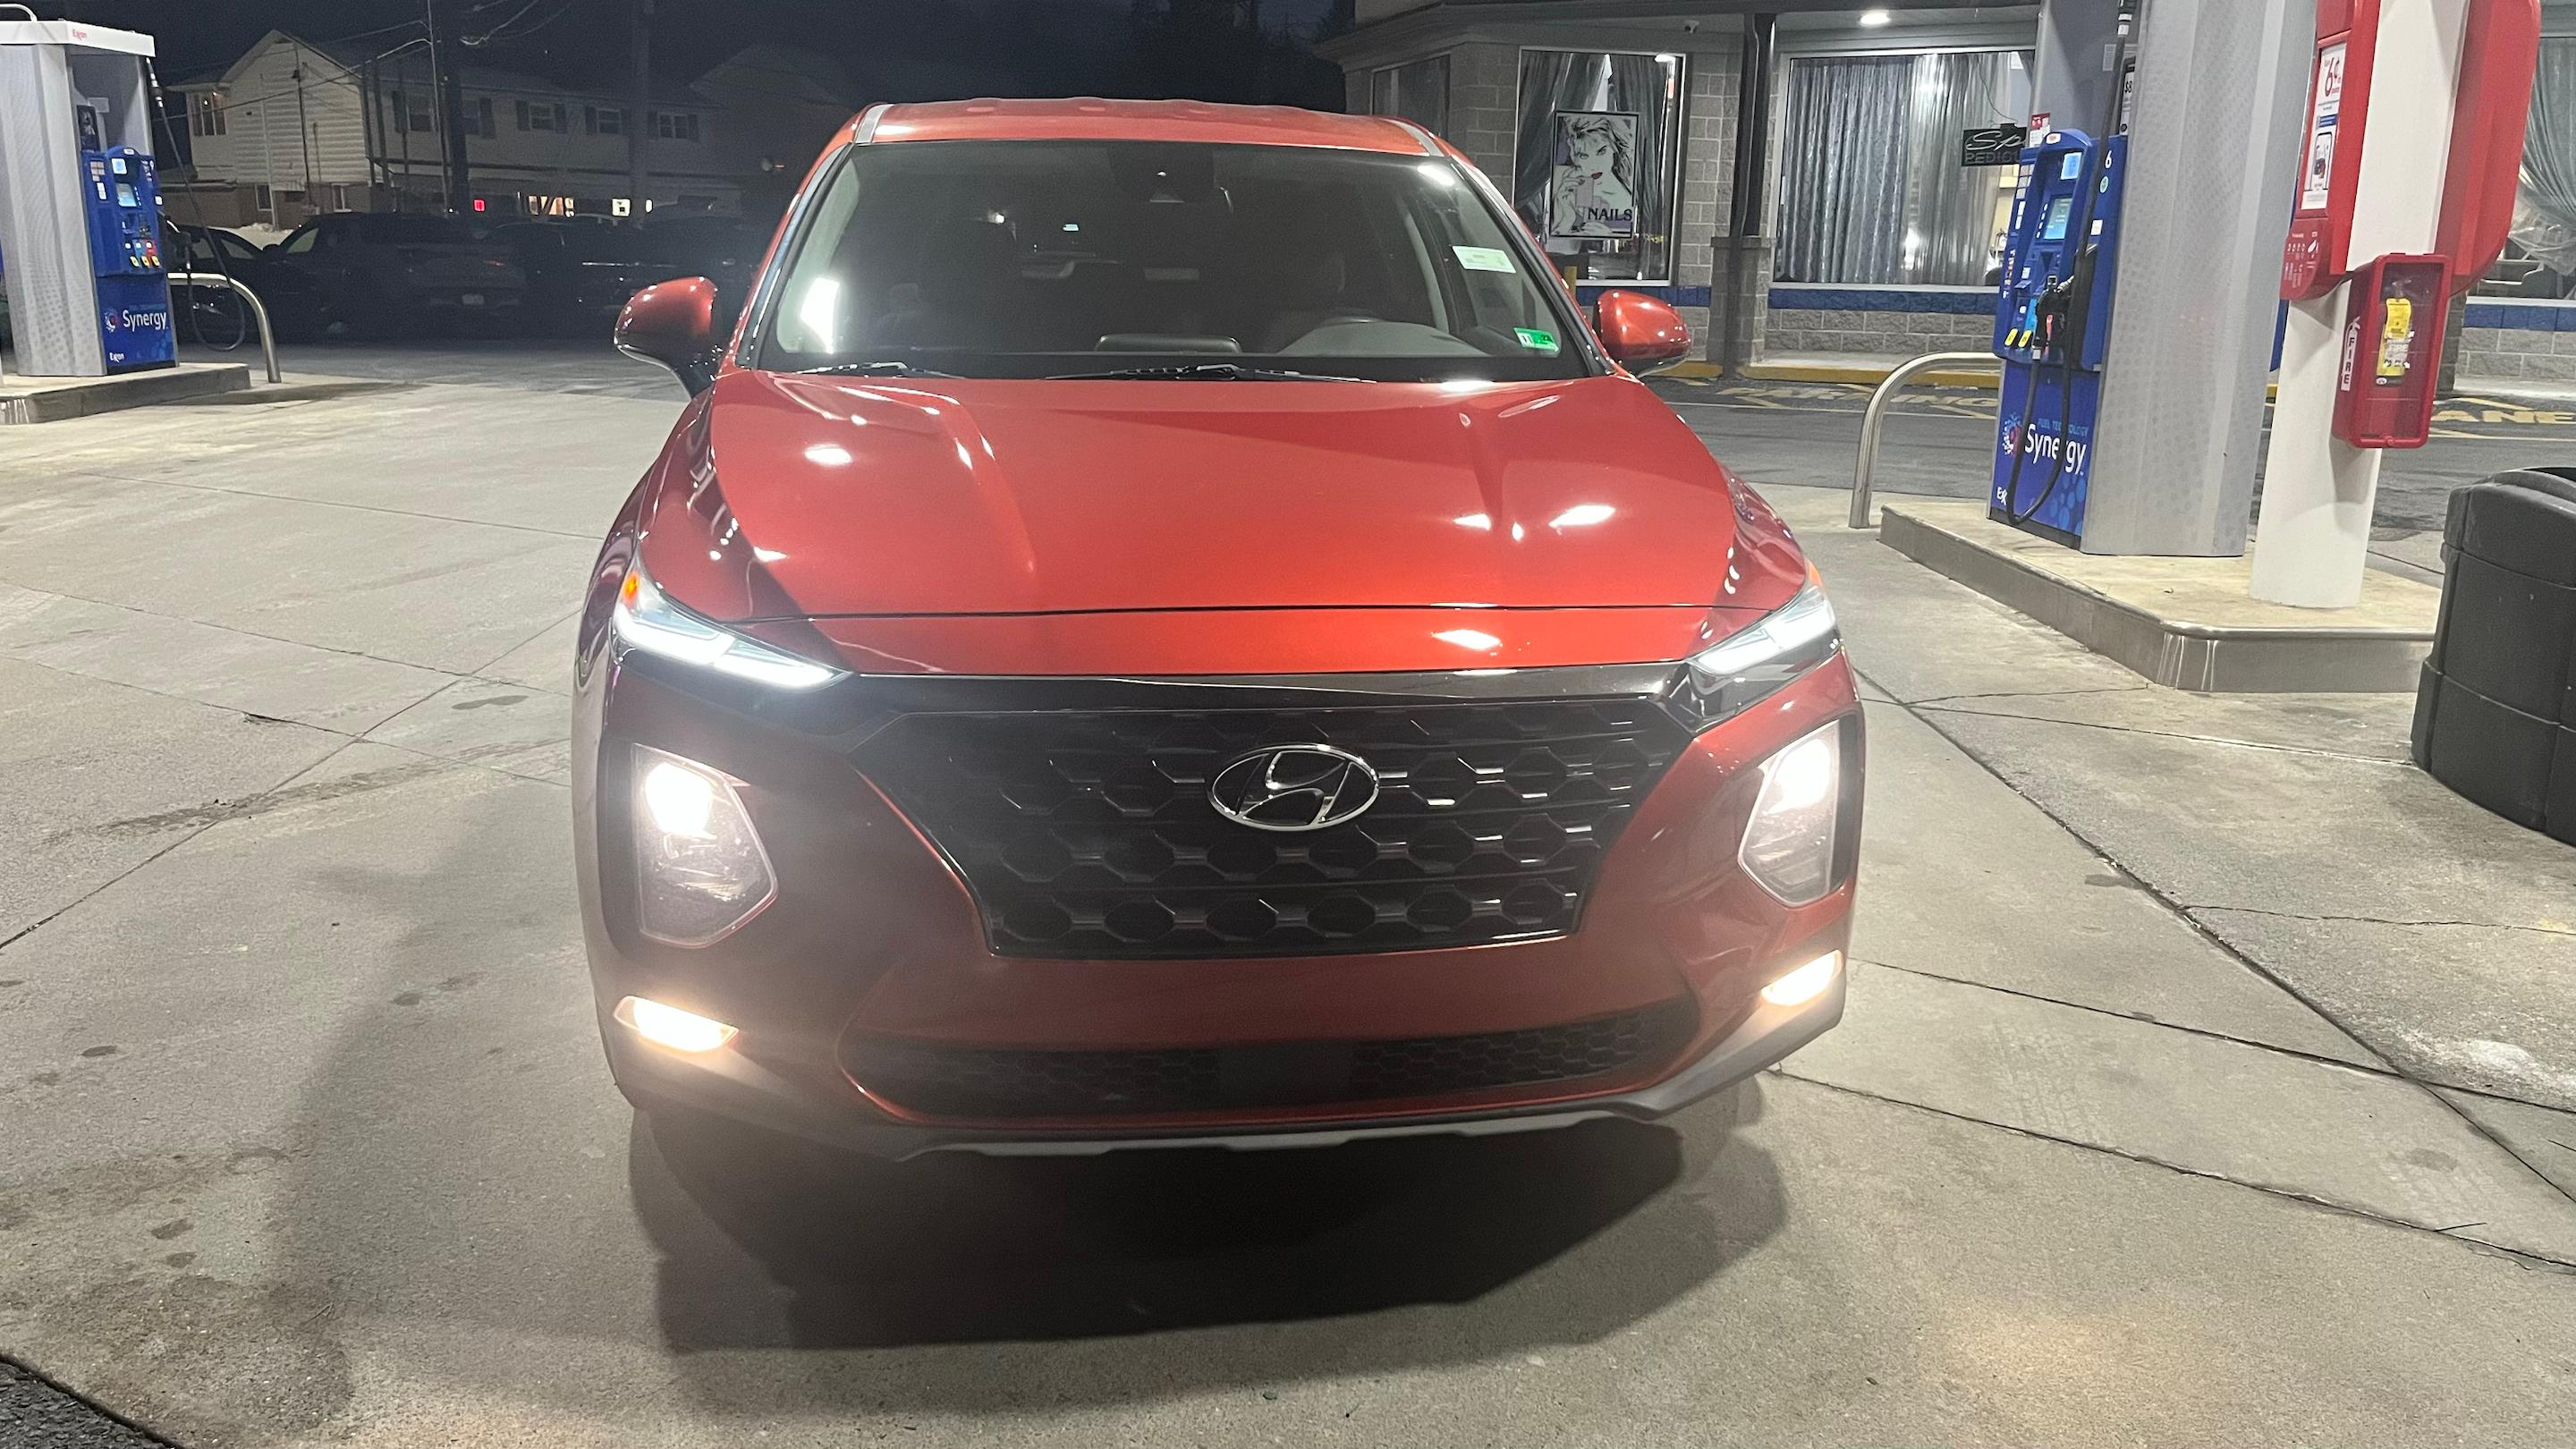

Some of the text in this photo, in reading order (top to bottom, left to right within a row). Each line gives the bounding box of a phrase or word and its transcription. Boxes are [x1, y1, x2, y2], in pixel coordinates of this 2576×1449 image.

[1966, 131, 2025, 151] Sp
[2105, 149, 2112, 169] 6
[1588, 207, 1632, 221] NAILS
[123, 309, 166, 332] Synergy
[2343, 337, 2355, 385] FIRE
[2430, 410, 2576, 424] ANE
[2024, 423, 2087, 475] Synegy
